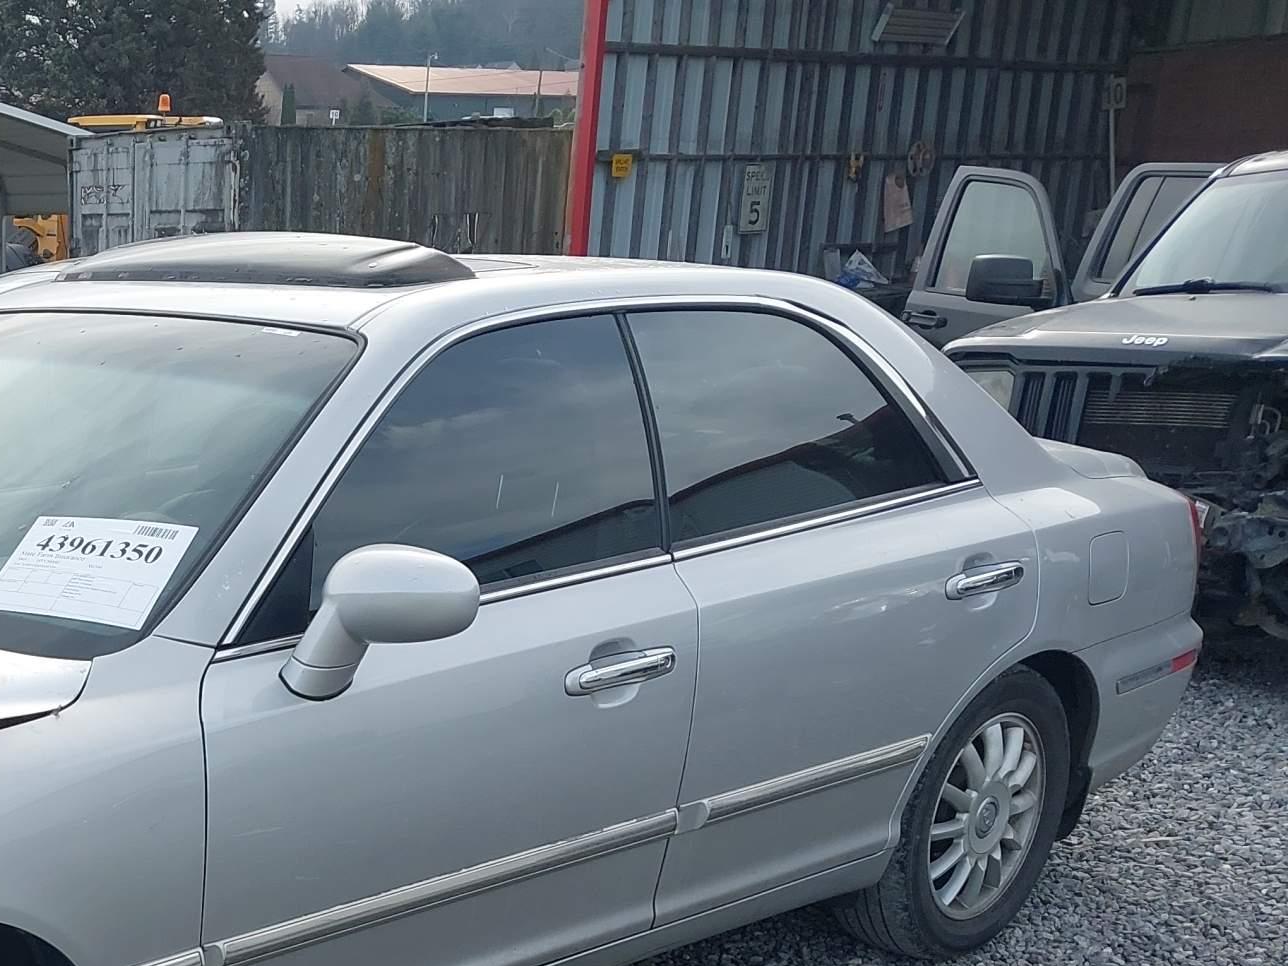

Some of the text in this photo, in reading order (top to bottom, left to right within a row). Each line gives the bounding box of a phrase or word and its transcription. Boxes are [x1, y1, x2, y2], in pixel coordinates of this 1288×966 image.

[746, 185, 768, 196] LIMIT
[748, 200, 761, 226] 5
[1122, 334, 1169, 347] Jeep
[36, 533, 163, 564] 43961350
